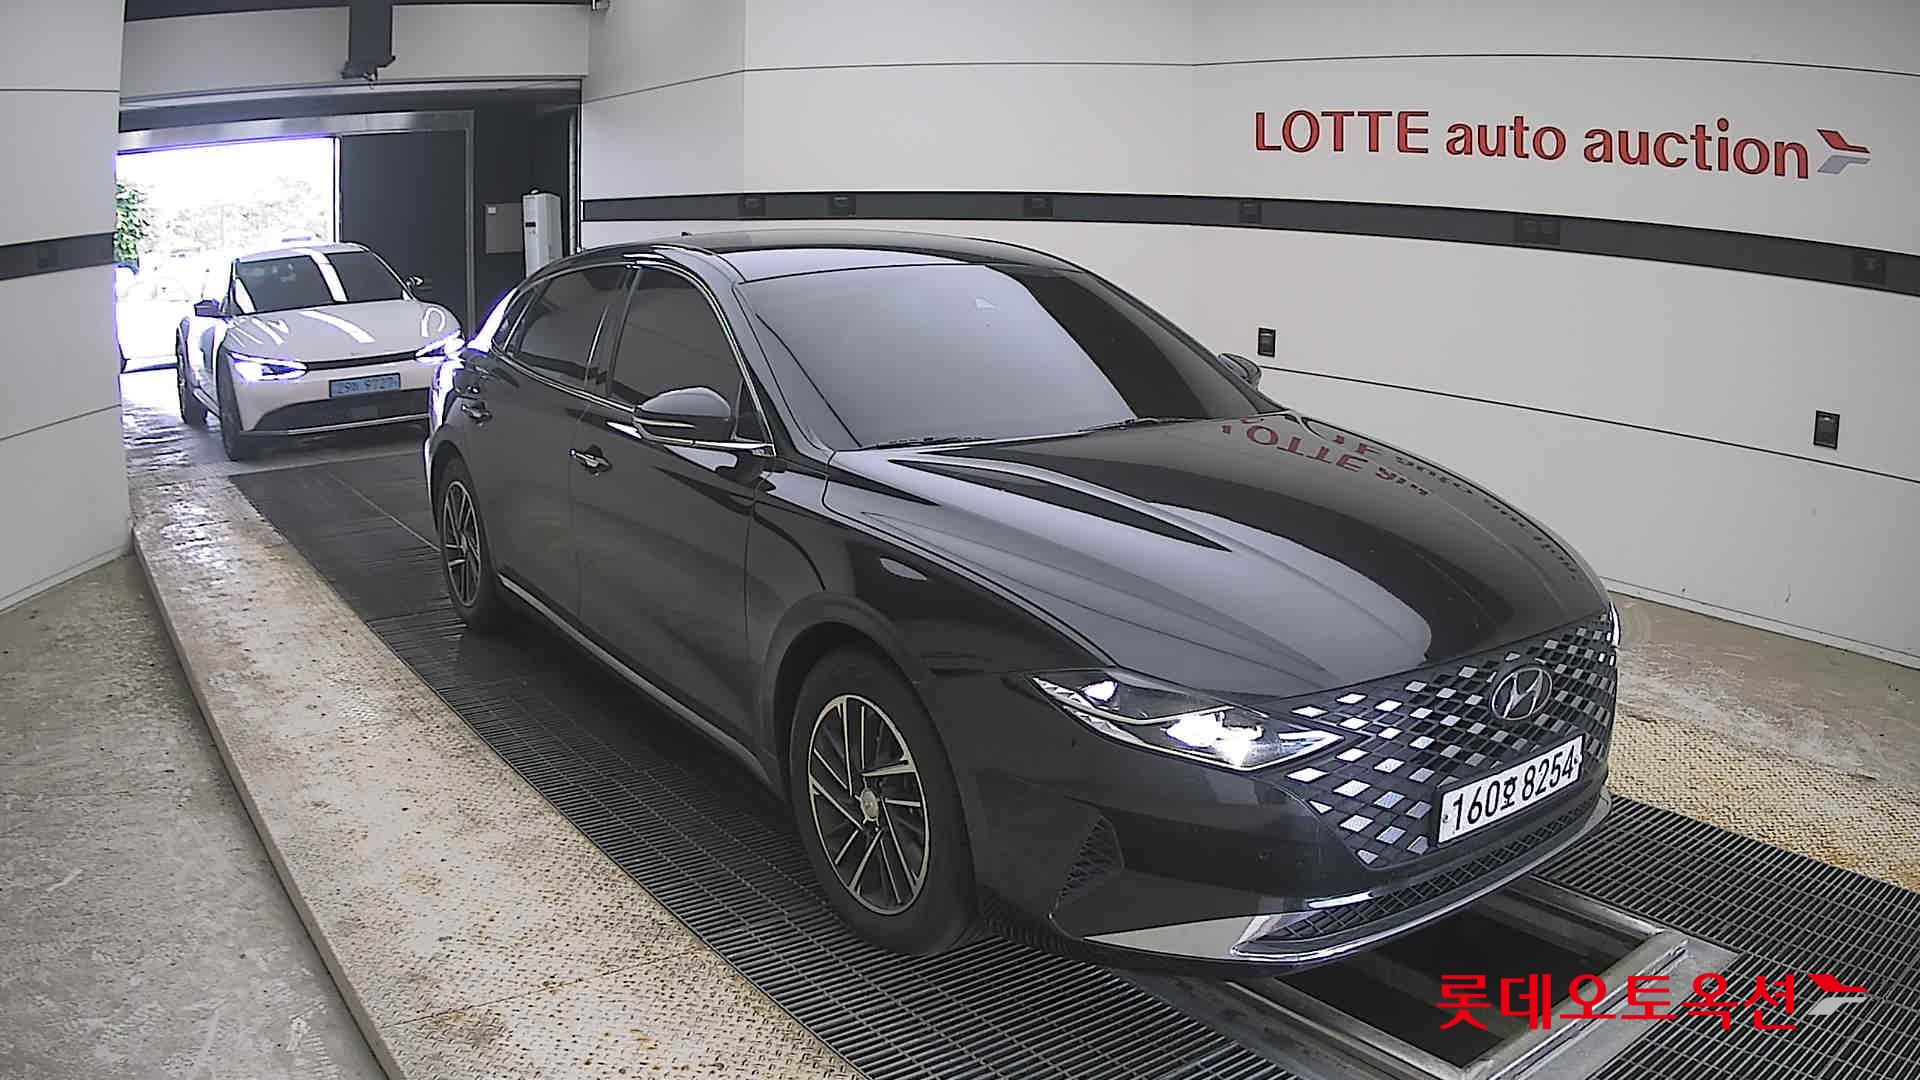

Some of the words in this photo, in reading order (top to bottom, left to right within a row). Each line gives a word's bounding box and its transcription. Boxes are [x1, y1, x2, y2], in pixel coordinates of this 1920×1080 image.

[1255, 110, 1429, 154] LOTTE
[1445, 115, 1567, 160] auto
[1583, 117, 1810, 180] auction
[1522, 744, 1576, 801] 8254
